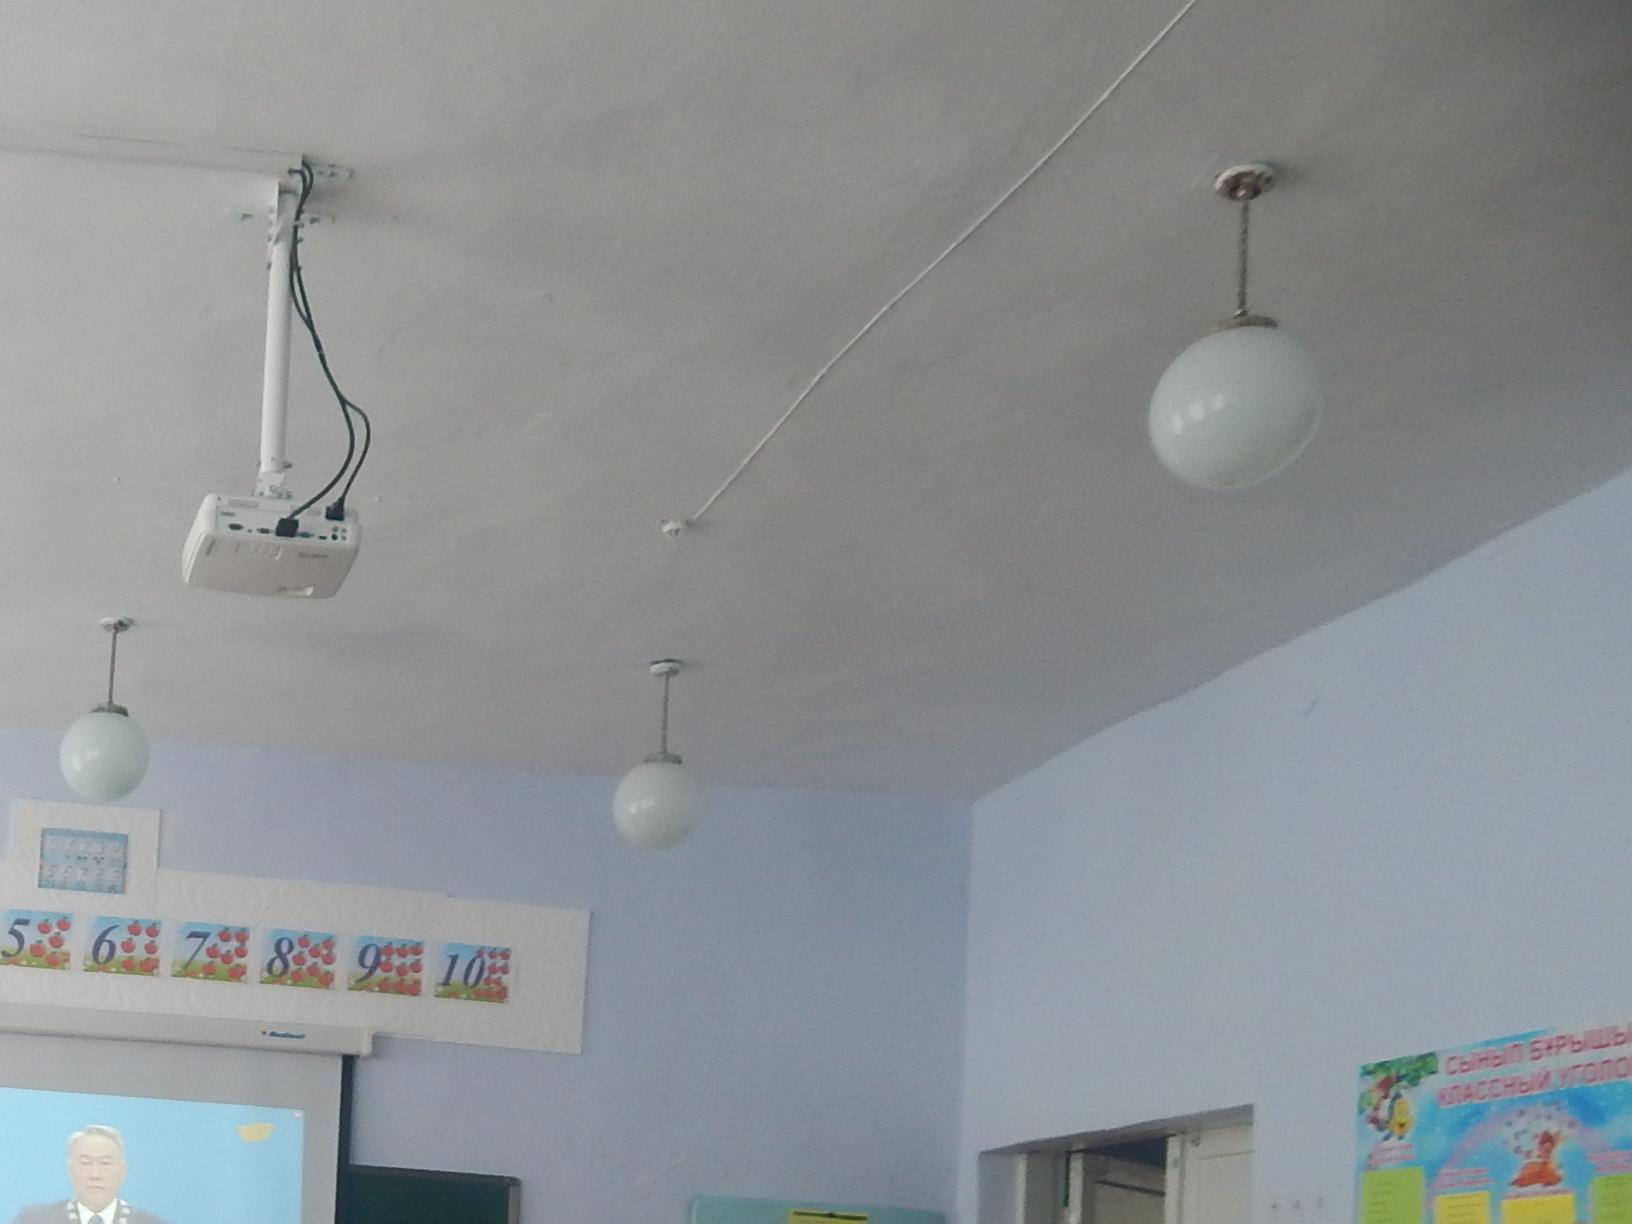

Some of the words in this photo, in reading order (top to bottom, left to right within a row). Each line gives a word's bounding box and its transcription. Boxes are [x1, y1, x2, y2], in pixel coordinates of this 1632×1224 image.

[0, 918, 31, 957] 5
[91, 924, 120, 966] 6
[182, 931, 212, 970] 7
[266, 937, 295, 978] 8
[355, 943, 383, 982] 9
[440, 952, 486, 989] 10
[1559, 1056, 1632, 1088] УГОЛО
